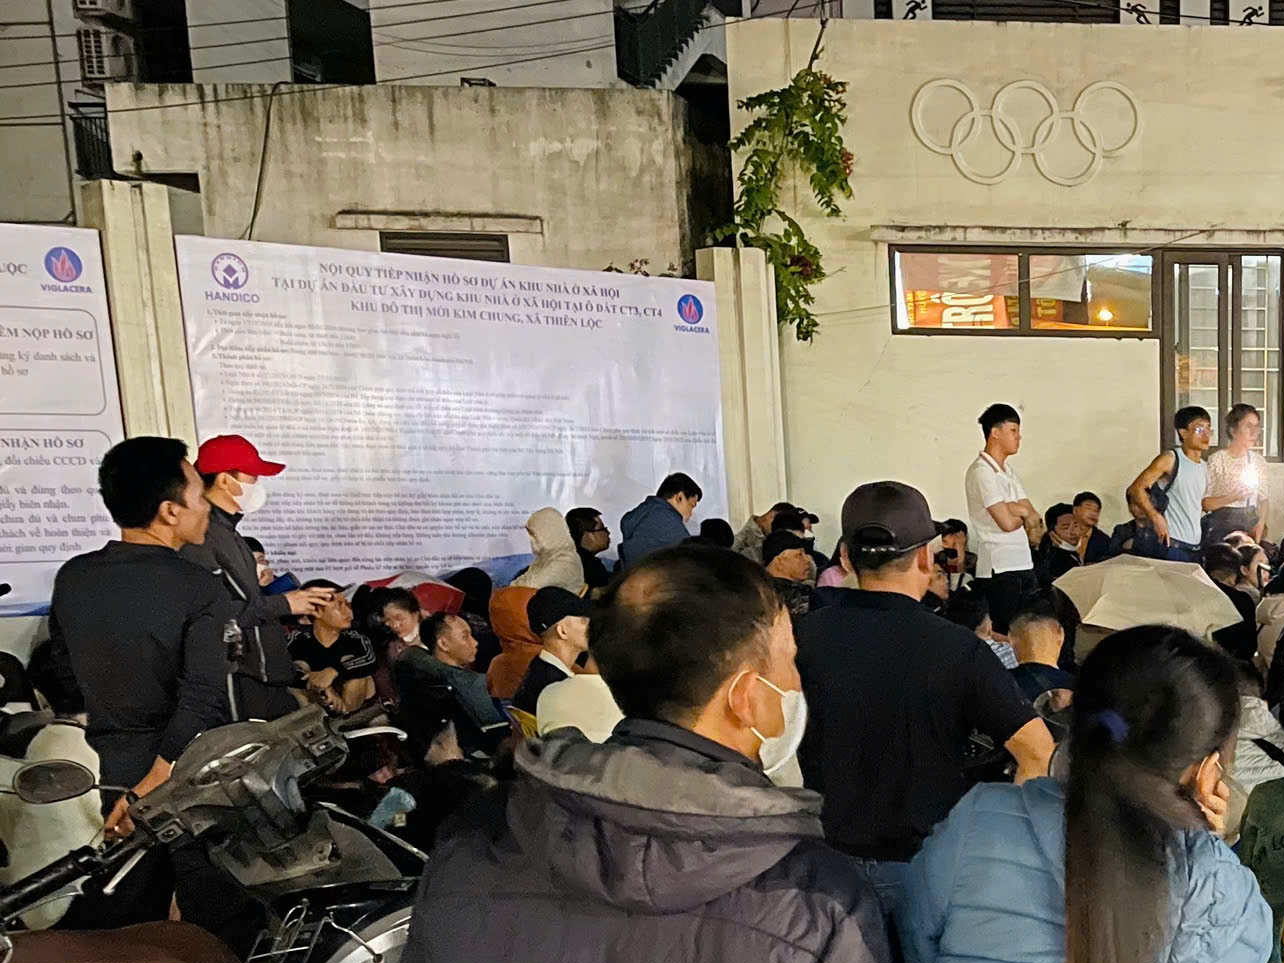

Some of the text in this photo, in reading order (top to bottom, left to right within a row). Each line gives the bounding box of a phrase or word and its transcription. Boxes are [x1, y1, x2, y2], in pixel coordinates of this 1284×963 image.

[319, 263, 343, 276] NỘI
[346, 265, 373, 278] QUY
[375, 267, 404, 280] TIẾP
[405, 271, 440, 284] NHẬN
[442, 271, 460, 286] HỒ
[463, 275, 479, 287] SƠ
[481, 278, 498, 291] DỰ
[500, 277, 516, 290] ÁN
[519, 282, 544, 293] KHU
[546, 283, 570, 295] NHÀ
[583, 285, 597, 297] XÃ
[600, 287, 620, 300] HỘI
[40, 283, 93, 294] VIGLACERA
[204, 291, 260, 304] HANDICO
[272, 276, 294, 291] TẠI
[298, 278, 317, 292] DỰ
[321, 279, 339, 292] ÁN
[370, 284, 389, 296] TƯ
[390, 285, 416, 299] XÂY
[419, 288, 454, 302] DỰNG
[456, 292, 482, 304] KHU
[485, 294, 509, 307] NHÀ
[523, 297, 539, 309] XÃ
[541, 299, 562, 312] HỘI
[565, 300, 584, 314] TẠI
[585, 301, 594, 313] Ô
[619, 306, 642, 318] CT3,
[643, 307, 663, 318] CT4
[350, 301, 603, 331] KHU ĐÔ THỊ MỚI KIM CHUNG, XÃ THIÊN LỘC
[75, 330, 94, 341] SƠ
[674, 325, 710, 334] VIGLACERA
[1, 436, 84, 450] NHẬN HỒ SƠ
[53, 456, 87, 466] CCCD
